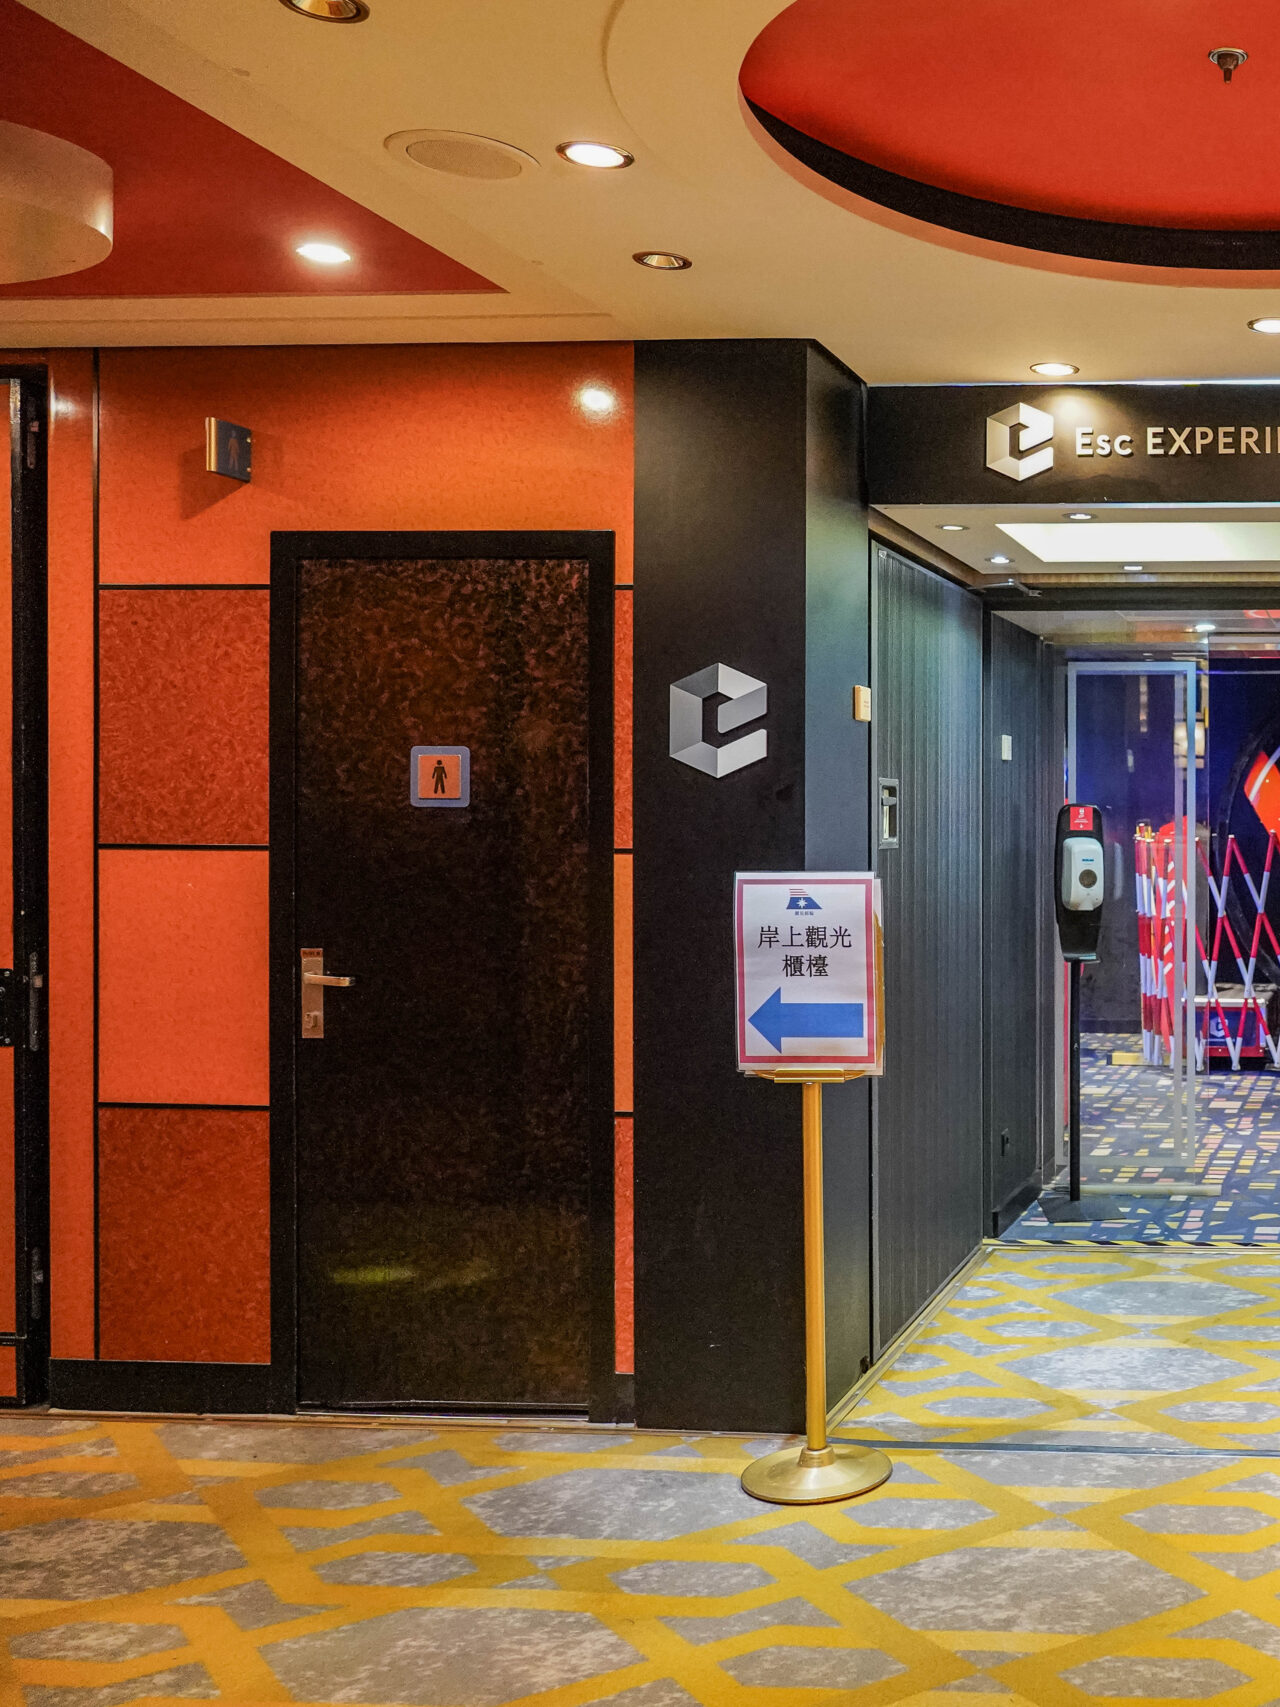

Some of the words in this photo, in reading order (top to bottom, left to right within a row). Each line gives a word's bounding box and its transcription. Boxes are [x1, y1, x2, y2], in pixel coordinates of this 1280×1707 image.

[1075, 426, 1133, 456] Esc
[758, 925, 852, 948] 岸上觀光
